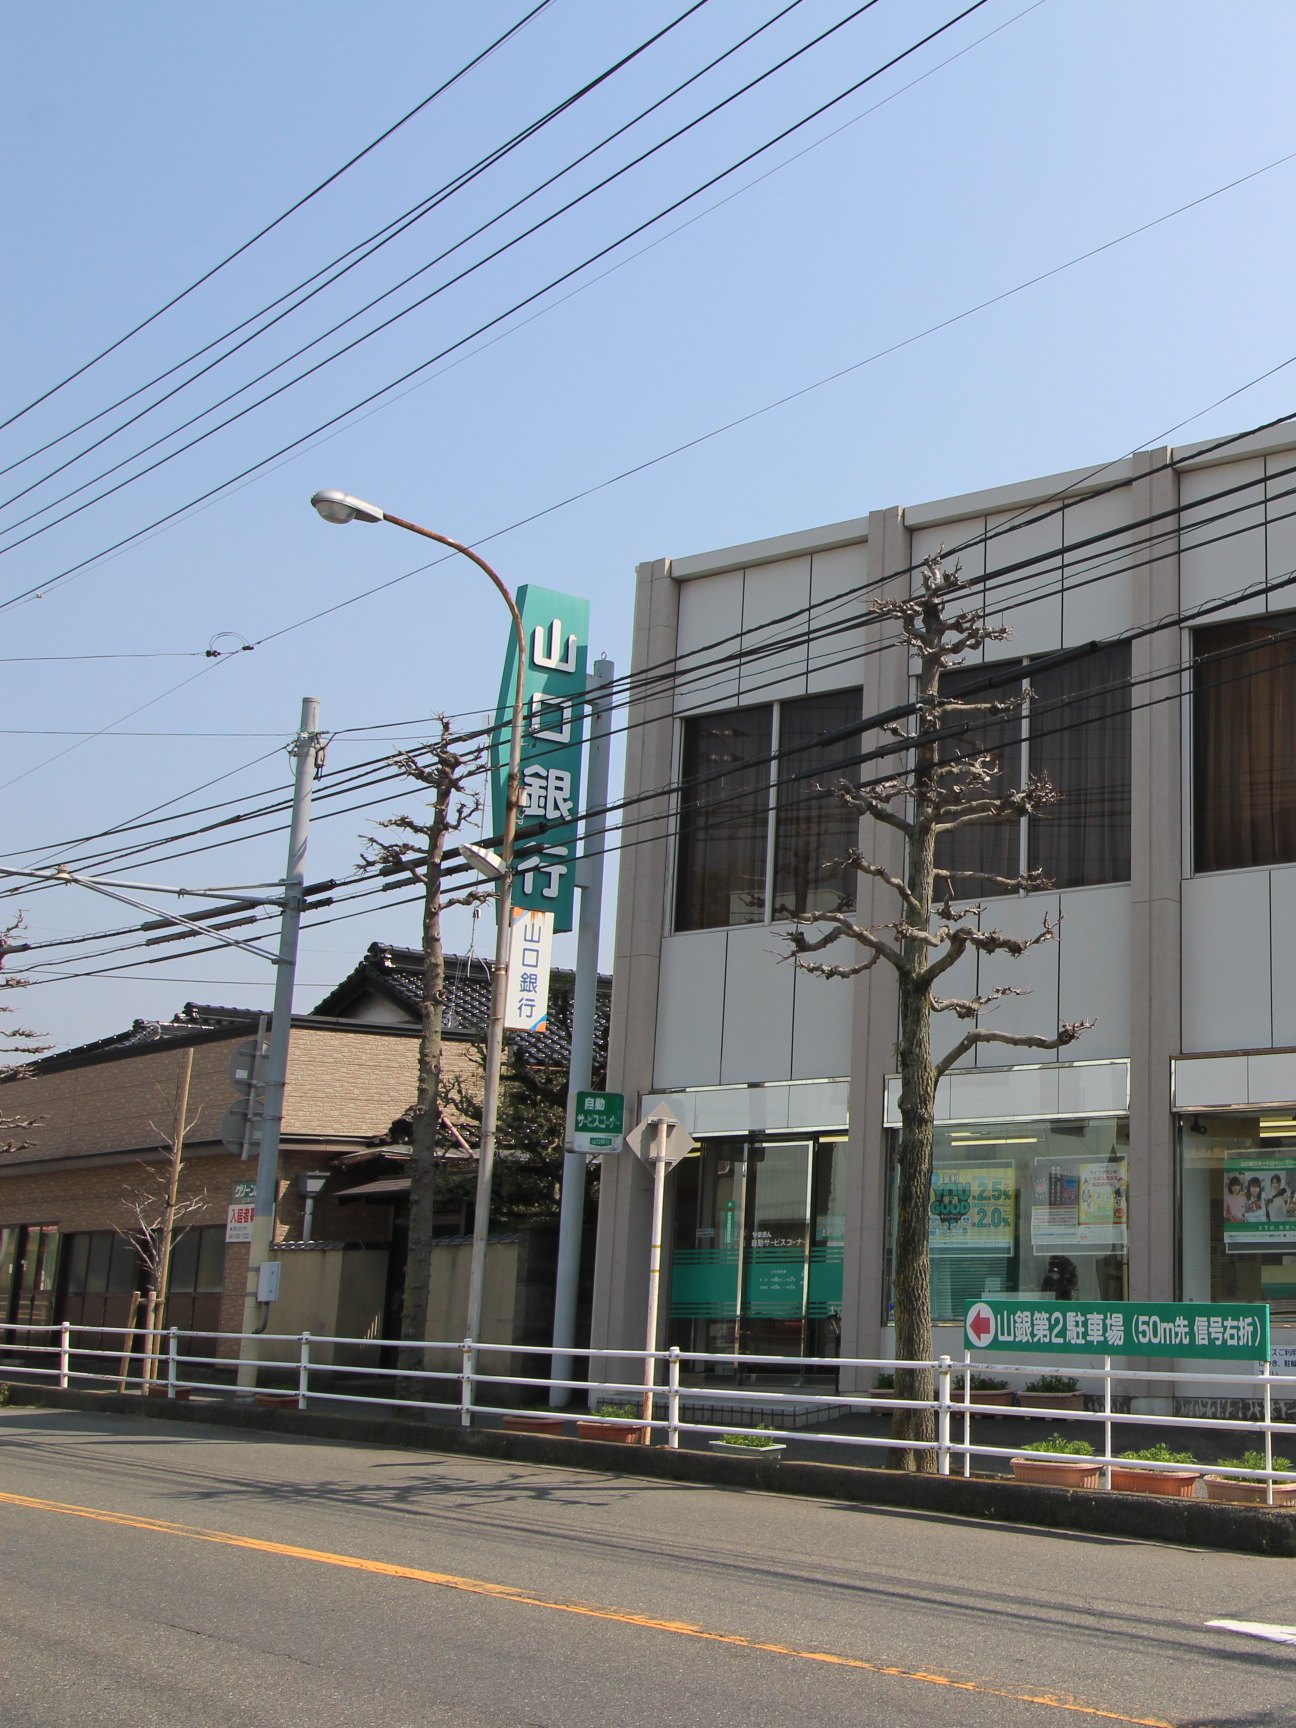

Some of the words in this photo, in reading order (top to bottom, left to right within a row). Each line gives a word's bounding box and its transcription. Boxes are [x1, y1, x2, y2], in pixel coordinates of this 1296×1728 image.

[517, 618, 578, 899] 山口銀行
[517, 922, 542, 1019] 山口銀行
[584, 1097, 606, 1111] 自動
[577, 1113, 621, 1129] サービスコーナー
[234, 1184, 258, 1198] グリーン
[932, 1182, 971, 1201] YOU
[930, 1200, 971, 1215] GOOD
